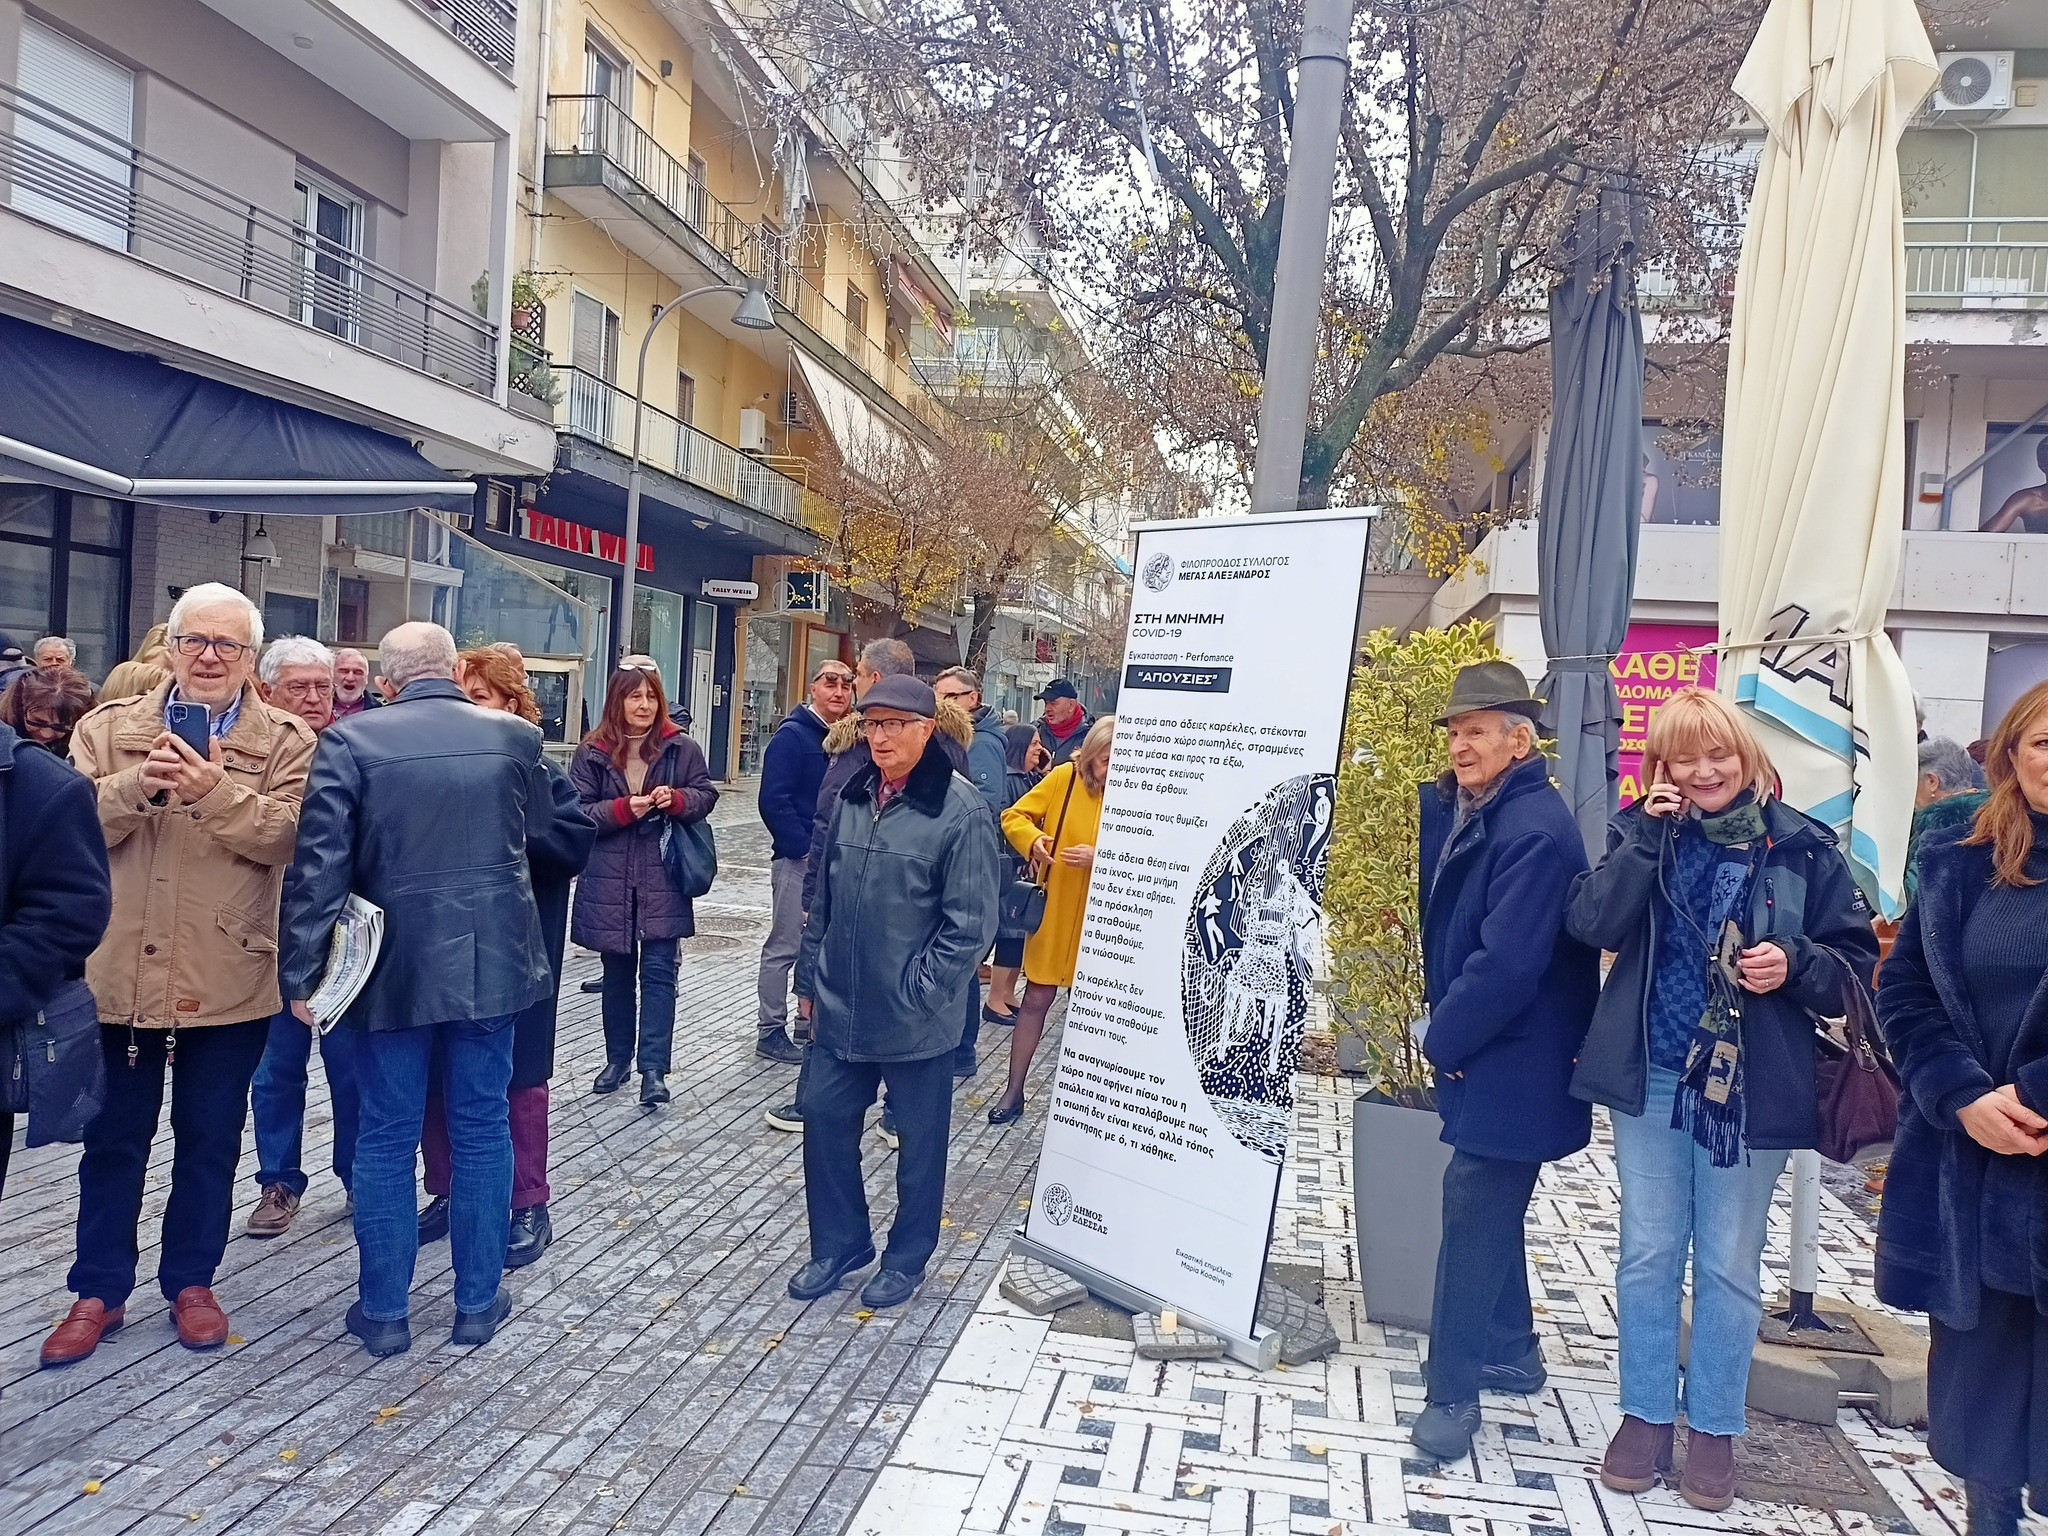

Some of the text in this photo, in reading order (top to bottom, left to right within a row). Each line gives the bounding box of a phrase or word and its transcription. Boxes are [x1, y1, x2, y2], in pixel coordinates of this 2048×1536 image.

[526, 508, 593, 554] TALLY
[1180, 556, 1290, 569] ΦΙΛΟΠΡΟΟΔΟΣ ΣΥΛΛΟΓΟΣ
[1178, 569, 1271, 581] ΜΕΓΑΣ ΑΛΕΞΑΝΔΡΟΣ
[1134, 613, 1225, 625] ΣΤΗ ΜΝΗΜΗ
[1132, 628, 1182, 638] COVID-19
[1128, 650, 1178, 662] Εγκατάσταση
[1185, 652, 1234, 662] Perfomance
[1138, 671, 1218, 685] “ΑΠΟΥΣΙΕΣ”
[1118, 715, 1307, 738] Μια σειρά απο άδειες καρέκλες, στέκονται
[1116, 731, 1305, 758] στον δημόσιο χώρο σιωπηλές, στραμμένες
[1113, 748, 1244, 769] προς τα μέσα και προς τα έξω,
[1111, 763, 1205, 782] περιμένοντας εκείνους
[1108, 778, 1188, 795] που δεν θα έρθουν.
[1111, 807, 1152, 820] παρουσία
[1155, 813, 1175, 825] τους
[1176, 813, 1208, 829] θυμίζει
[1102, 822, 1155, 837] την απουσία.
[1097, 848, 1190, 873] Κάθε άδεια θέση είναι
[1094, 864, 1178, 890] ένα ίχνος, μια μνήμη
[1092, 882, 1176, 905] που δεν έχει σβήσει.
[1089, 896, 1153, 919] Μια πρόσκληση
[1087, 914, 1142, 933] να σταθούμε,
[1084, 929, 1144, 950] να θυμηθούμε,
[1082, 945, 1136, 965] να νιώσουμε.
[1077, 971, 1144, 996] Οι καρέκλες δεν
[1074, 986, 1165, 1019] ζητούν να καθίσουμε.
[1071, 1002, 1159, 1035] Ζητούν να σταθούμε
[1068, 1020, 1128, 1046] απέναντι τους.
[1063, 1047, 1166, 1086] Να αναγνωρίσουμε τον
[1061, 1064, 1084, 1078] χώρο
[1086, 1072, 1102, 1084] που
[1103, 1078, 1133, 1095] αφήνει
[1135, 1087, 1159, 1102] πίσω
[1161, 1096, 1178, 1108] του
[1058, 1081, 1208, 1138] απώλεια και να καταλάβουμε πως
[1053, 1113, 1103, 1139] συνάντησης
[1104, 1131, 1116, 1142] με
[1130, 1140, 1138, 1149] τι
[1140, 1143, 1177, 1163] χάθηκε.
[1063, 1100, 1090, 1117] σιωπή
[1091, 1106, 1106, 1120] δεν
[1107, 1114, 1130, 1129] είναι
[1132, 1123, 1156, 1139] κενό,
[1159, 1130, 1183, 1146] αλλά
[1186, 1140, 1215, 1159] τόπος
[1072, 1214, 1108, 1235] ΕΔΕΣΣΑΣ
[1074, 1205, 1104, 1222] ΔΗΜΟΣ
[1181, 1260, 1200, 1274] Μαρία
